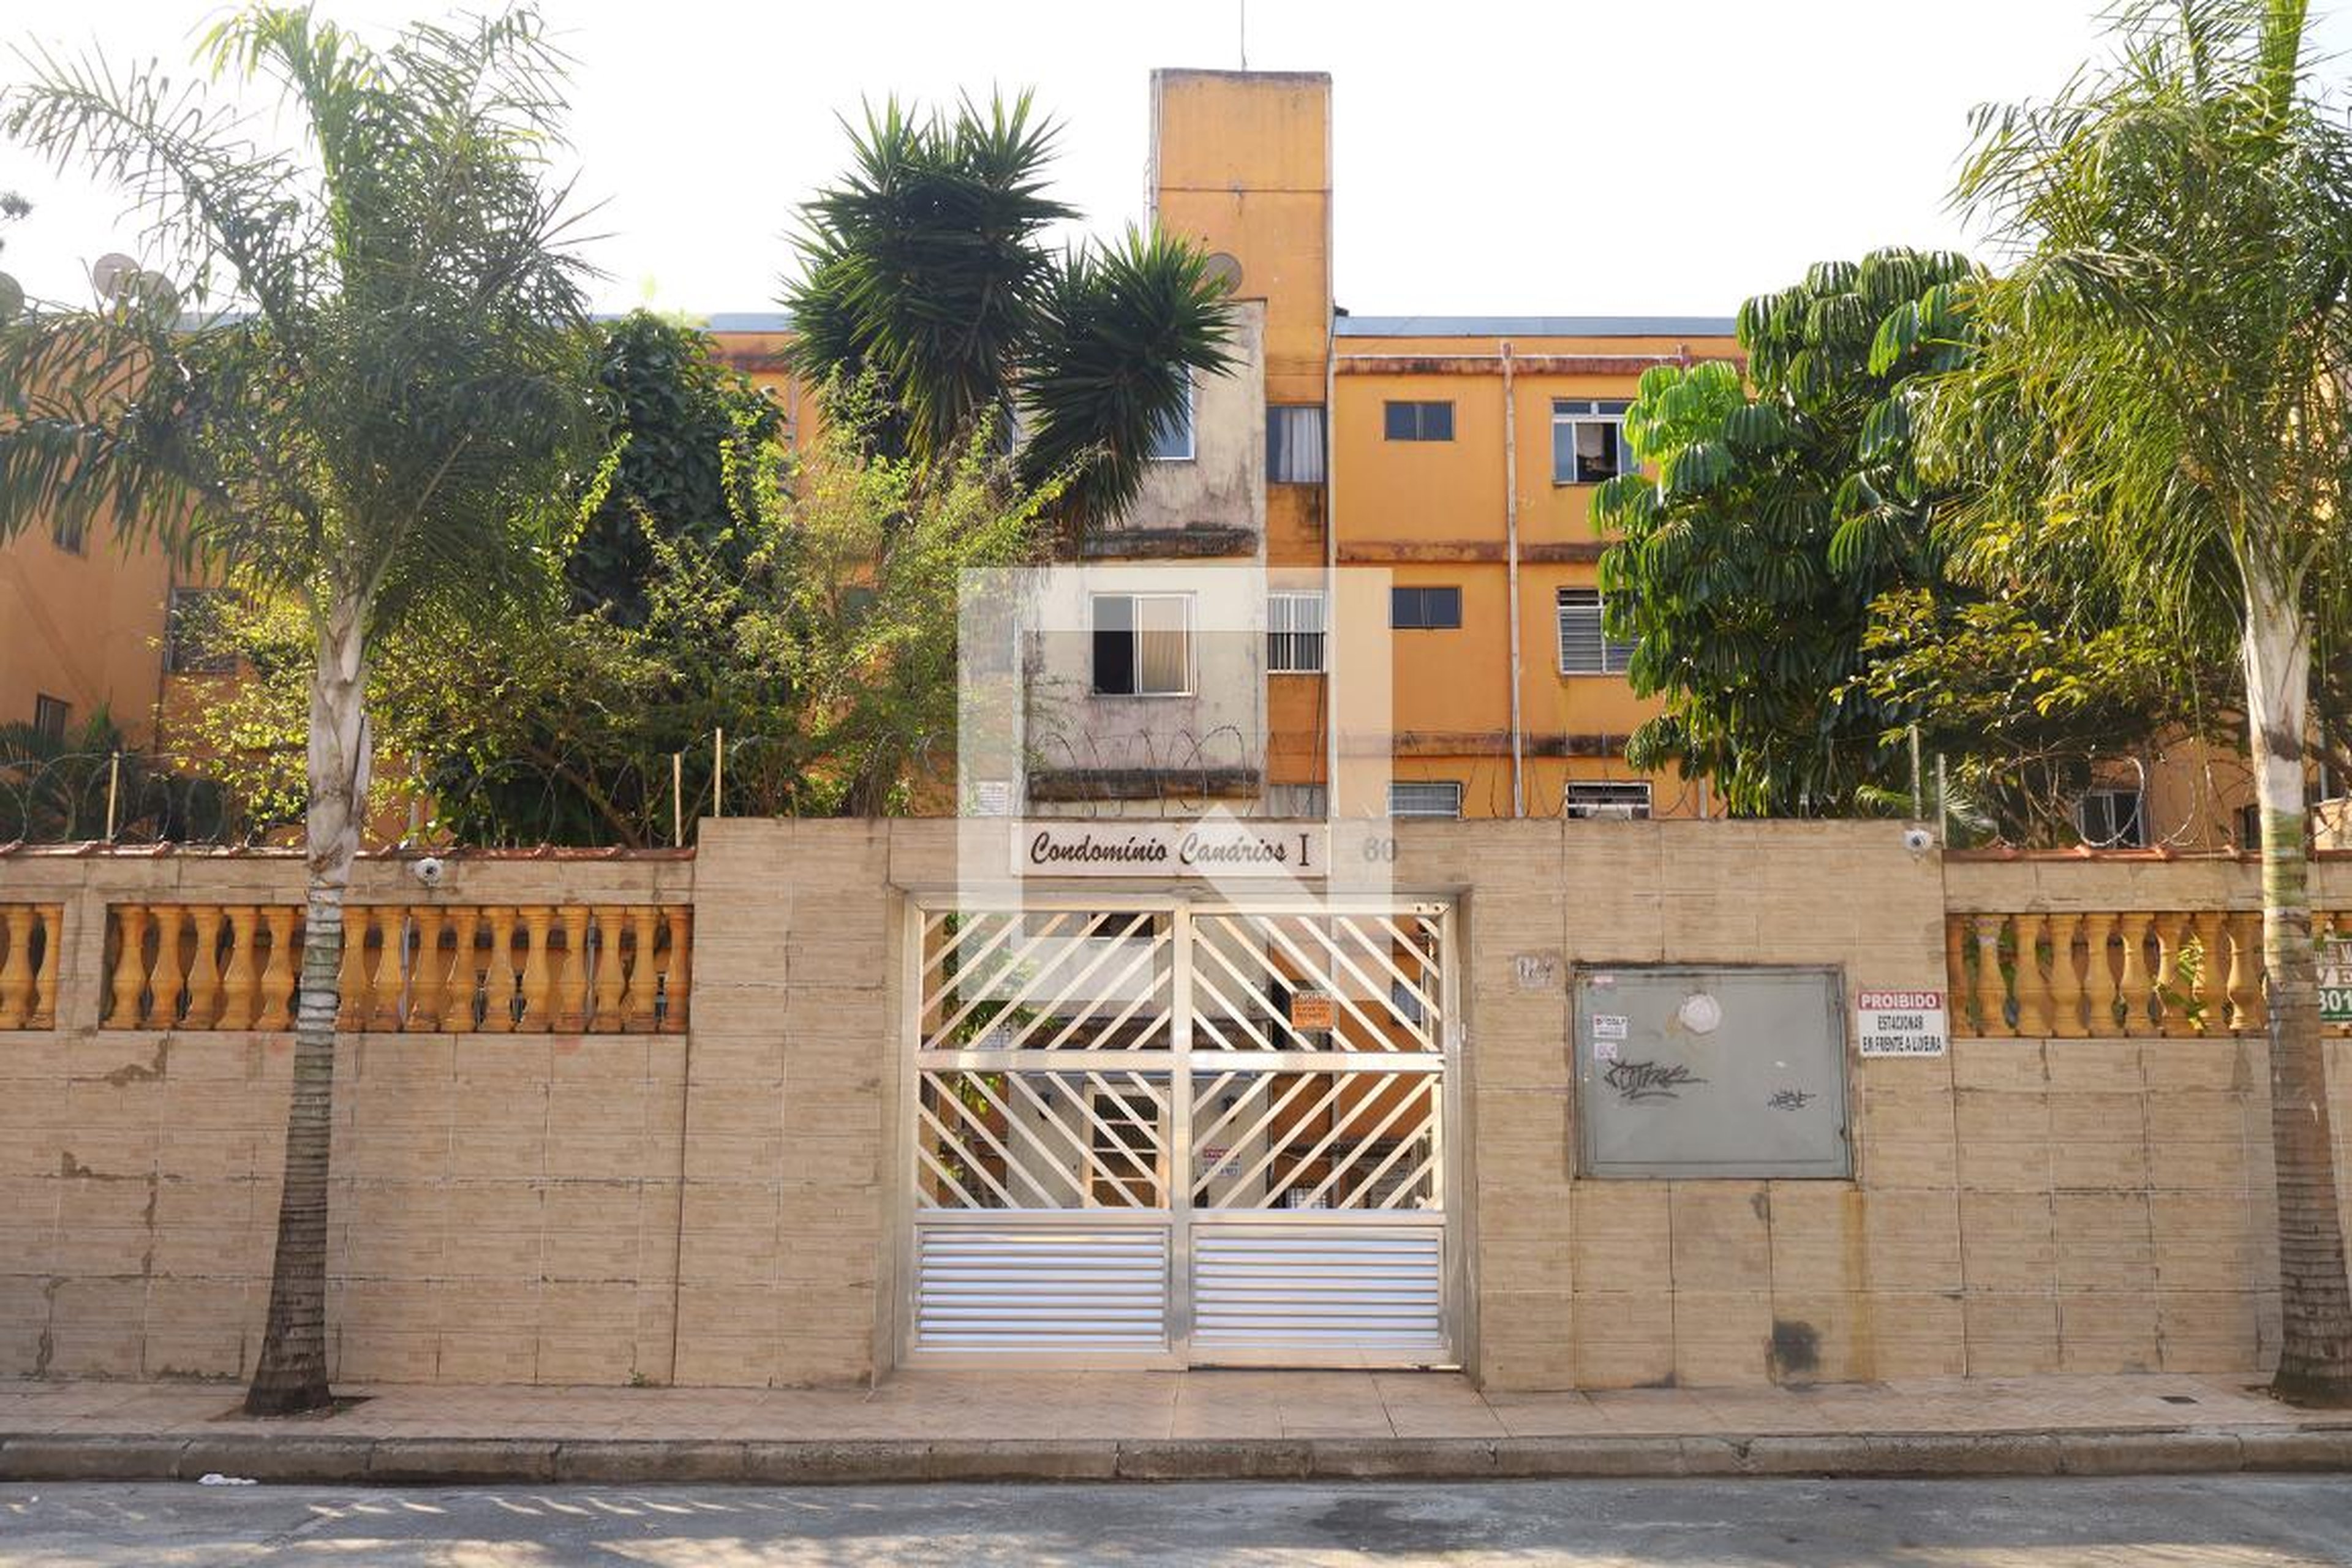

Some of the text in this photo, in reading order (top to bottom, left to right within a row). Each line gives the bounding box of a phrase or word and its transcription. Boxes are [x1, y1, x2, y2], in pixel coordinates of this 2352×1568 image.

[1030, 831, 1310, 867] Condomínio Canários I
[1861, 993, 1937, 1008] PROIBIDO
[1877, 1015, 1924, 1031] ESTACIONAR
[1875, 1036, 1904, 1052] FRENTE
